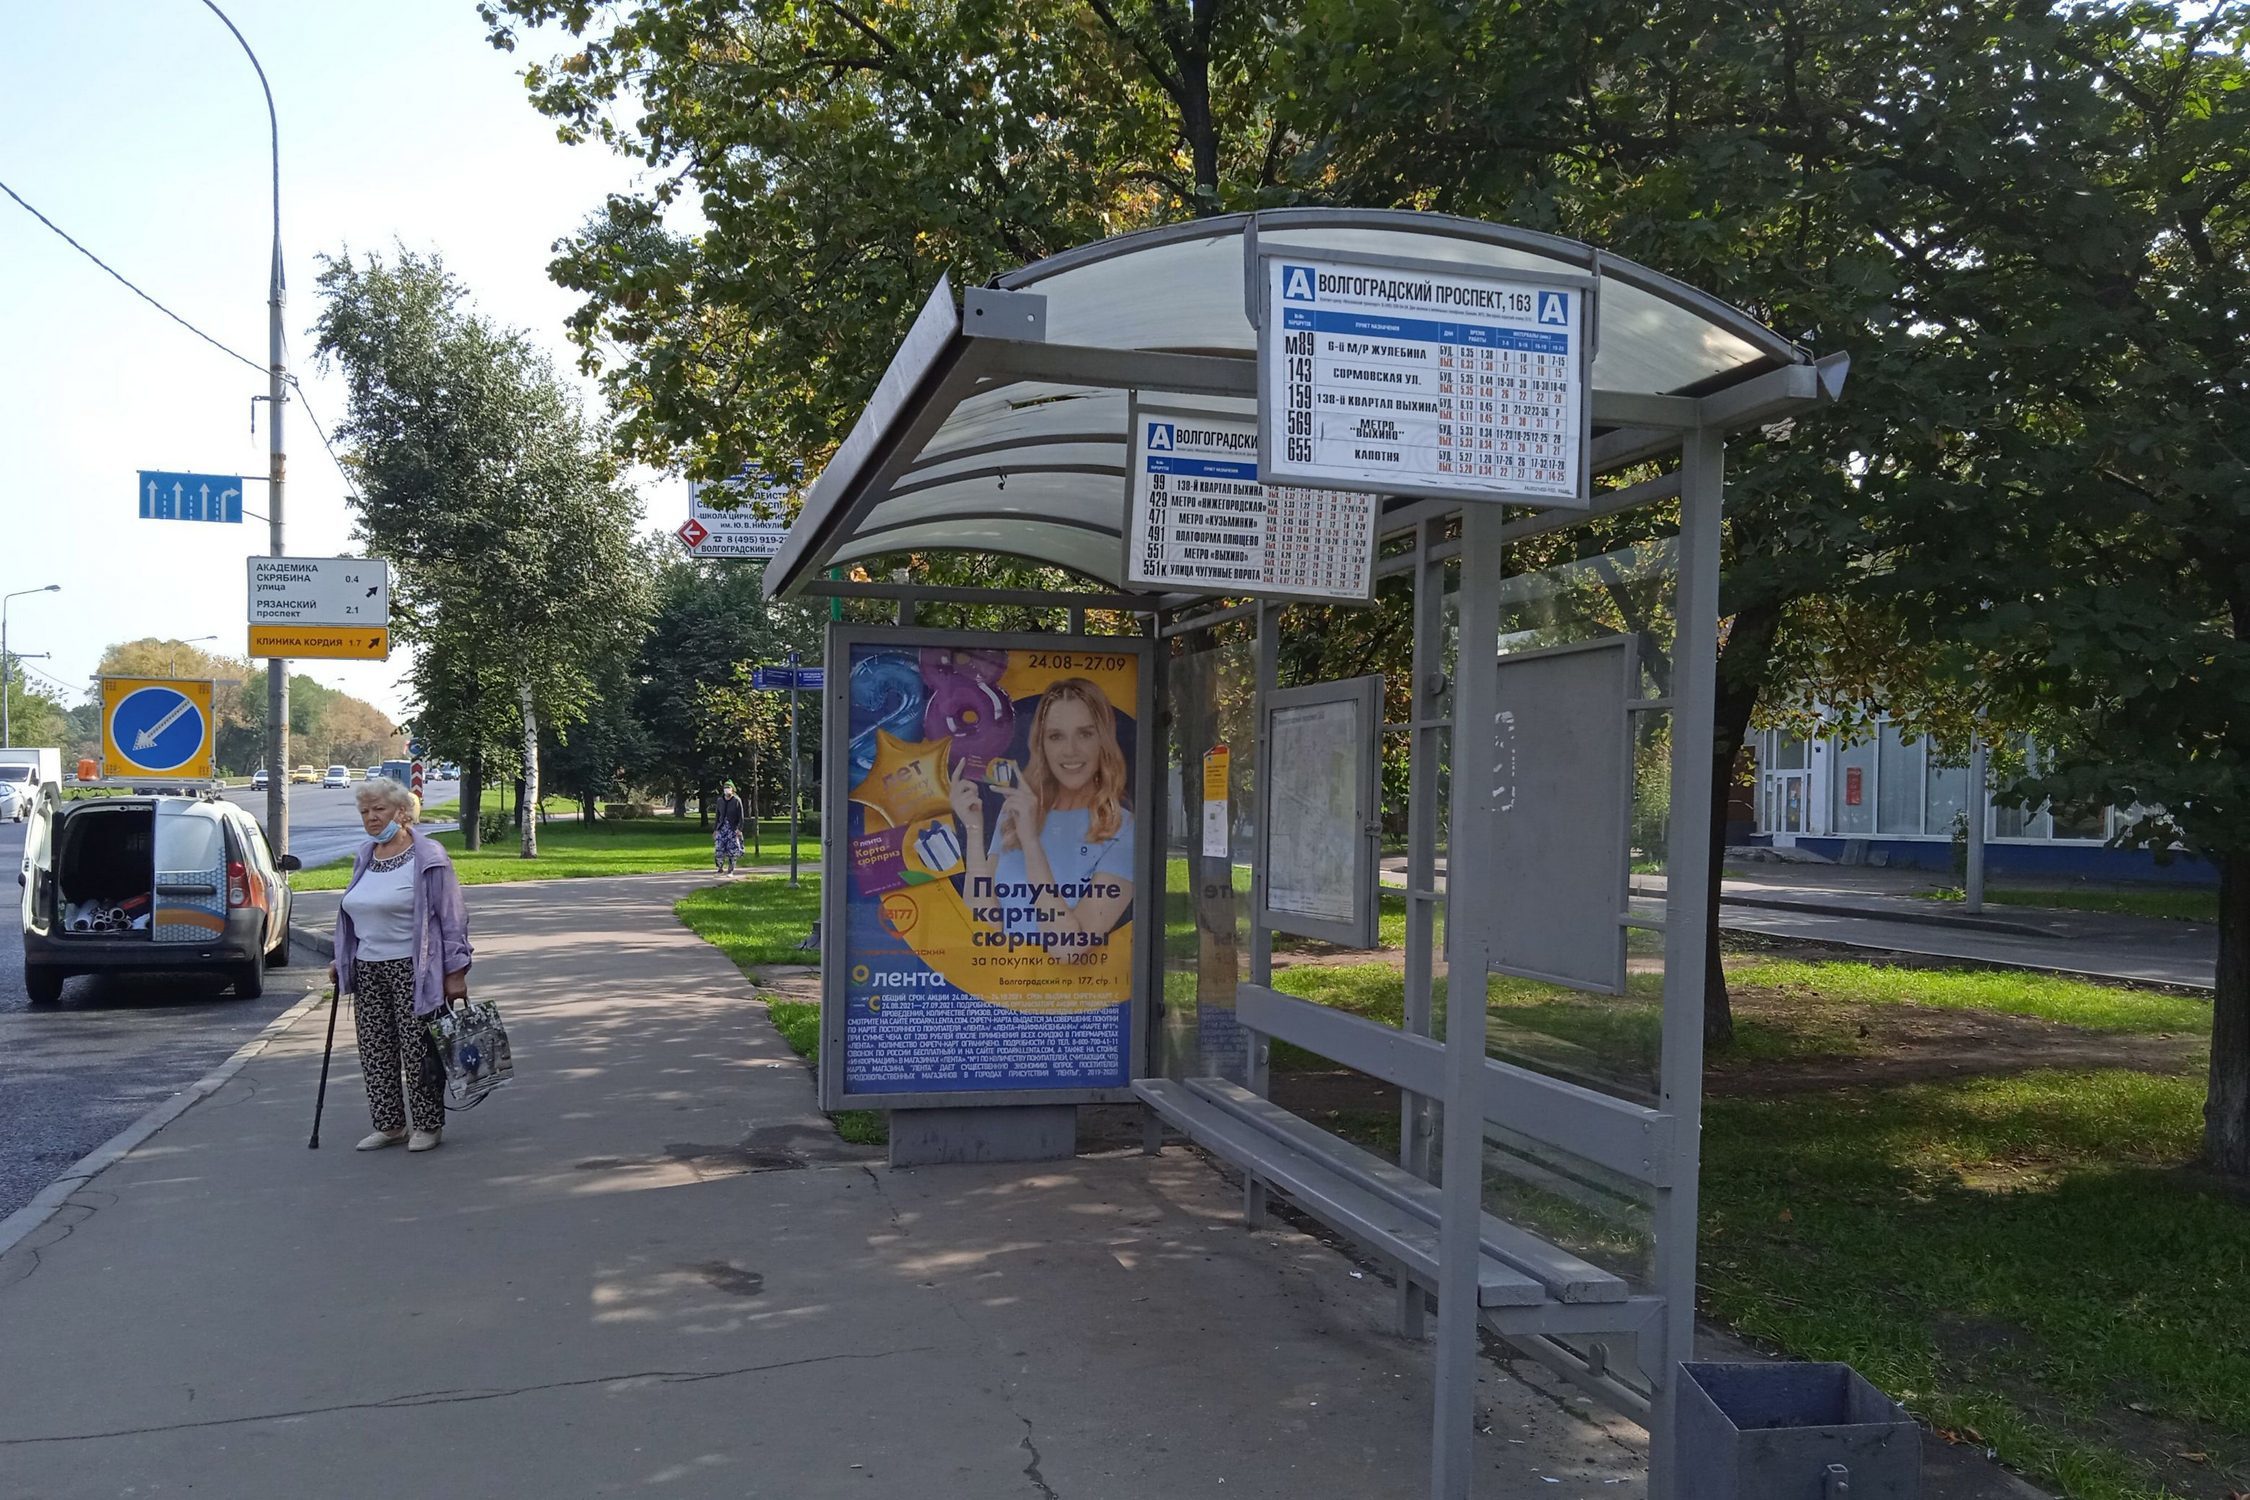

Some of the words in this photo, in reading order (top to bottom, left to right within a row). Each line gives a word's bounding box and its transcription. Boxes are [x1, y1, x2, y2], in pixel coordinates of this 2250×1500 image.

[1319, 274, 1432, 303] ВОЛГОГРАДСКИЙ
[1436, 285, 1506, 312] ПРОСПЕКТ,
[1509, 293, 1531, 312] 163
[1347, 343, 1369, 356] М/Р
[1371, 344, 1427, 359] ЖУЛЕБИНА
[1288, 357, 1312, 382] 143
[1333, 367, 1402, 383] СОРМОВСКАЯ
[1405, 374, 1422, 385] УЛ.
[1502, 364, 1509, 374] 17
[1520, 366, 1527, 376] 15
[1555, 369, 1562, 379] 15
[1288, 384, 1312, 409] 159
[1348, 396, 1393, 409] КВАРТАЛ
[1396, 400, 1438, 413] ВЫХИНА
[1288, 411, 1312, 436] 569
[1360, 418, 1394, 431] МЕТРО
[1176, 429, 1258, 450] ВОЛГОГРАДСКИ
[1287, 437, 1312, 462] 655
[1354, 449, 1400, 462] КАПОТНЯ
[1153, 474, 1165, 490] 99
[1177, 478, 1198, 492] 138-Й
[1199, 481, 1232, 494] КВАРТАЛ
[1233, 484, 1263, 496] ВЫХИНА
[1149, 492, 1167, 507] 429
[1171, 495, 1196, 508] МЕТРО
[1197, 499, 1267, 513] «НИЖЕГОРОДСКАЯ»
[1149, 509, 1166, 525] 471
[1178, 513, 1203, 525] МЕТРО
[1205, 515, 1257, 528] «КУЗЬМИНКИ»
[734, 535, 758, 544] (495)
[1148, 526, 1165, 542] 491
[1176, 530, 1221, 544] ПЛАТФОРМА
[1222, 534, 1259, 547] ПЛЮЩЕВО
[701, 544, 766, 554] ВОЛГОГРАДСКИЙ
[1147, 543, 1164, 559] 551
[1184, 548, 1209, 560] МЕТРО
[1210, 550, 1248, 562] «ВЫХИНО»
[256, 563, 319, 572] АКАДЕМИКА
[1170, 565, 1194, 577] УЛИЦА
[1195, 566, 1232, 579] ЧУГУННЫЕ
[1234, 569, 1260, 580] ВОРОТА
[256, 574, 311, 582] СКРЯБИНА
[345, 575, 359, 583] 0.4
[257, 584, 286, 592] улица
[257, 600, 317, 609] РЯЗАНСКИЙ
[345, 606, 359, 614] 2.1
[257, 611, 301, 619] проспект
[256, 638, 301, 646] КЛИНИКА
[304, 638, 343, 647] КОРДИЯ
[974, 876, 1121, 904] Получайте
[973, 907, 1066, 929] карты-
[972, 931, 1110, 953] сюрпризы
[971, 956, 987, 966] за
[991, 956, 1043, 969] покупки
[1047, 957, 1061, 966] от
[872, 971, 946, 987] лента
[999, 976, 1060, 986] Волгоградский
